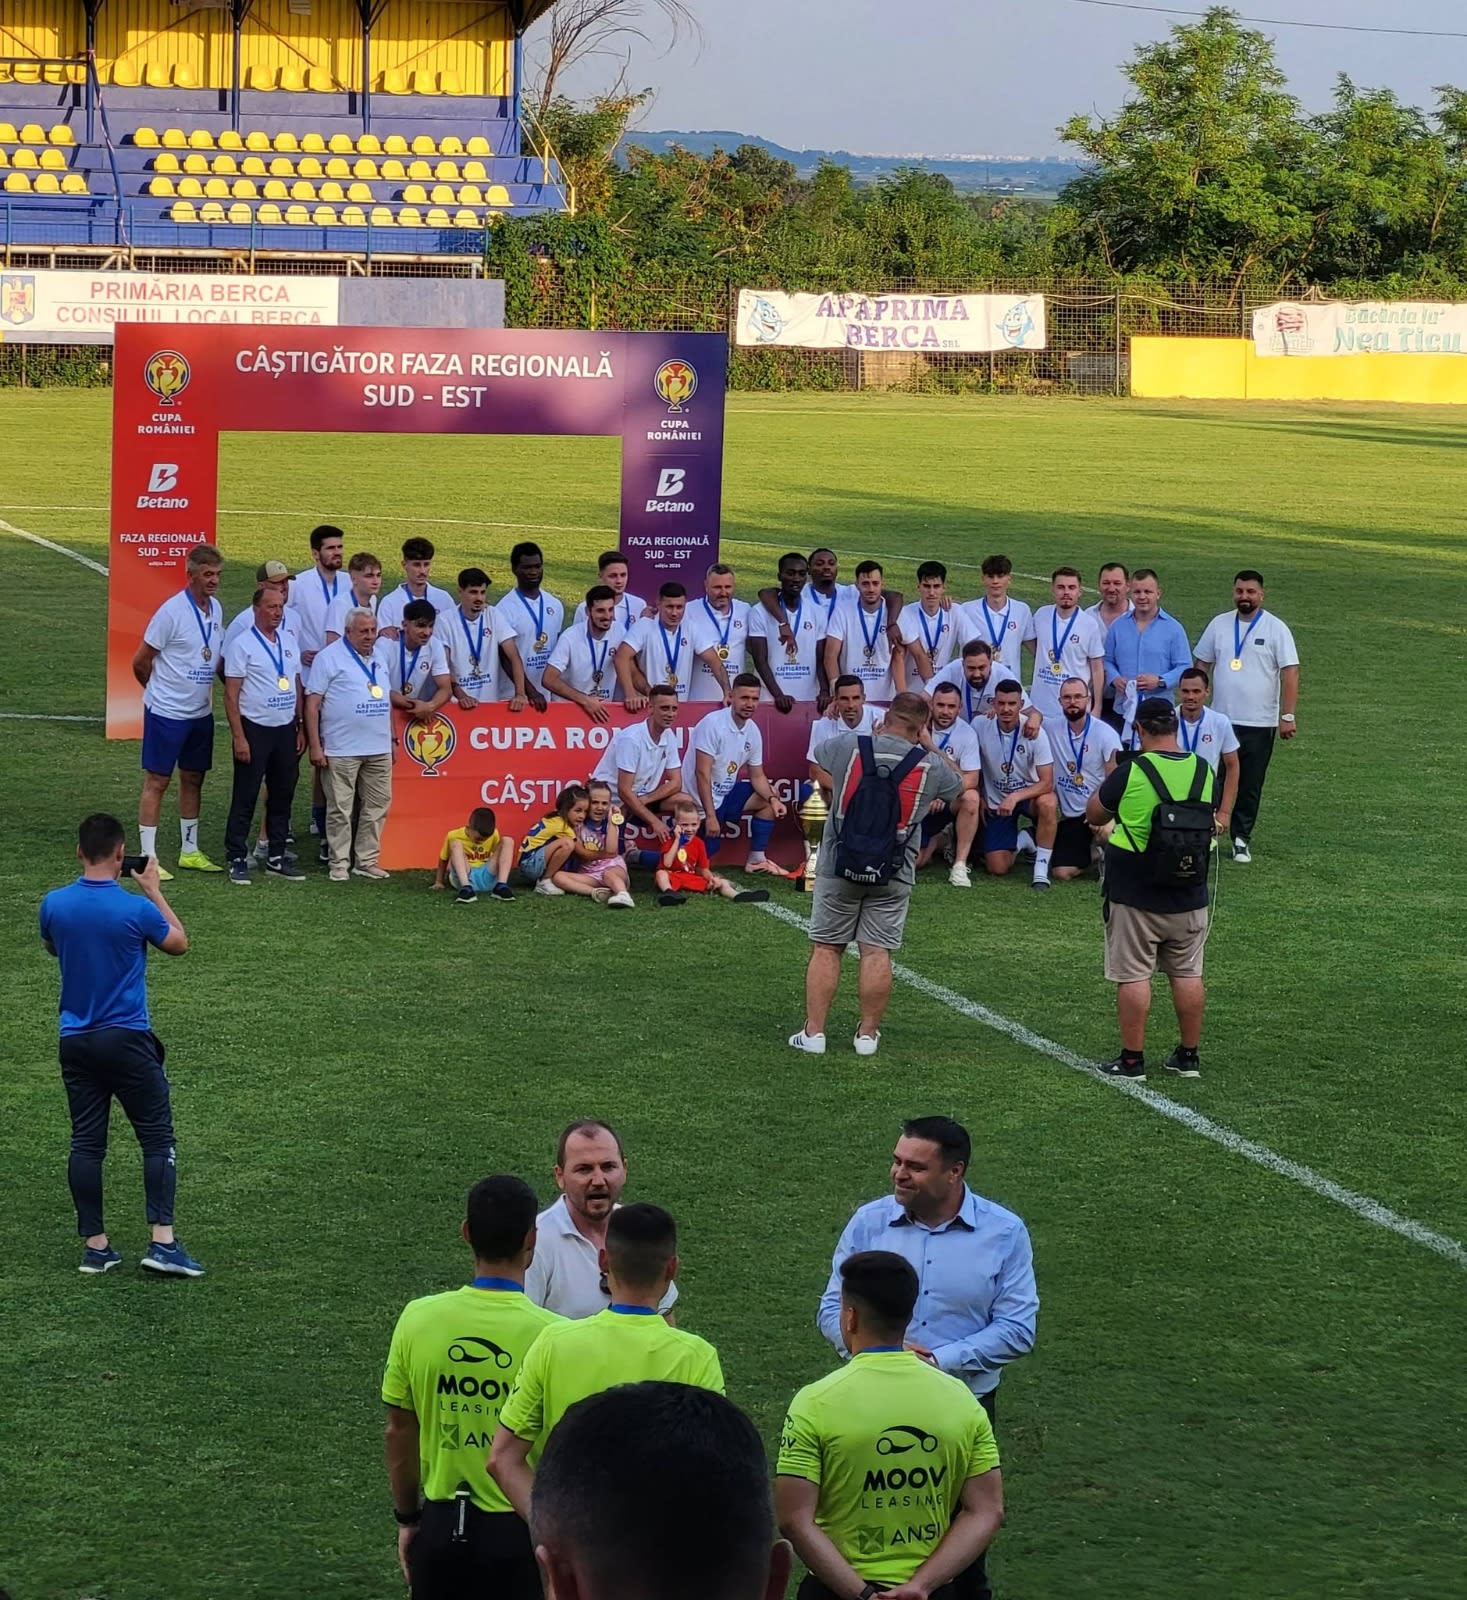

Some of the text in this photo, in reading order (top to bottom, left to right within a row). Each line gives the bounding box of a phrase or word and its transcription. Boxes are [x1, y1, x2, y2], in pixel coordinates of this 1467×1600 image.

[90, 279, 290, 302] PRIMĂRIA BERCA
[845, 323, 960, 348] BERCA SRL
[1333, 326, 1390, 352] Nea
[1398, 327, 1461, 352] Ticu
[235, 345, 614, 378] CÂȘTIGĂTOR FAZA REGIONALĂ
[363, 384, 415, 407] SUD
[441, 386, 487, 408] EST
[152, 413, 182, 422] CUPA
[137, 424, 195, 434] ROMÂNIEI
[660, 420, 689, 429] CUPA
[647, 429, 702, 441] ROMÂNIEI
[136, 496, 189, 509] Betano
[645, 500, 694, 512] Betano
[120, 532, 206, 543] FAZA REGIONALĂ
[628, 534, 709, 546] FAZA REGIONALĂ
[138, 547, 159, 556] SUD
[169, 547, 187, 556] EST
[645, 550, 664, 559] SUD
[674, 550, 692, 559] EST
[469, 727, 557, 749] CUPA
[440, 1400, 502, 1417] LEASIN
[862, 1465, 948, 1492] MOOV
